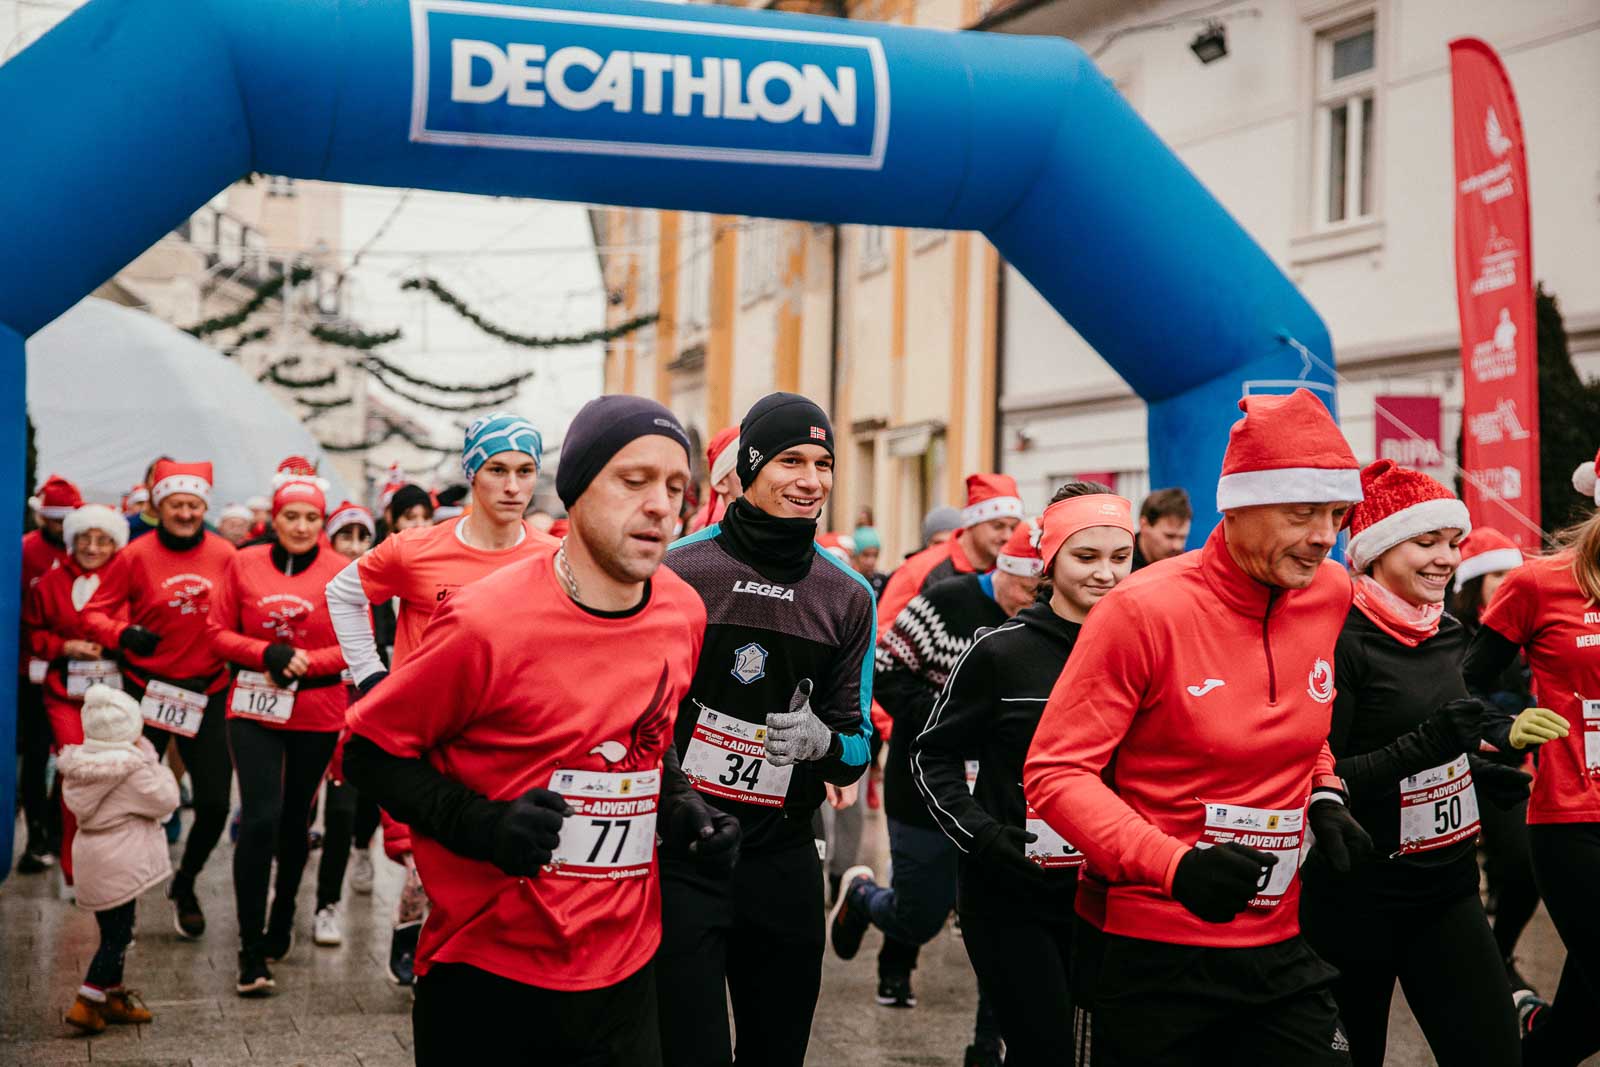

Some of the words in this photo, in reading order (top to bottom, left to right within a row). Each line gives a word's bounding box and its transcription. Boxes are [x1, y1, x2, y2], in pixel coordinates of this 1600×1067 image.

[450, 38, 857, 126] DECATHLON
[732, 580, 795, 602] LEGEA
[156, 703, 187, 726] 103
[248, 692, 278, 714] 102
[723, 739, 766, 756] «ADVEN
[719, 753, 763, 791] 34
[1434, 795, 1462, 834] 50
[585, 820, 631, 863] 77
